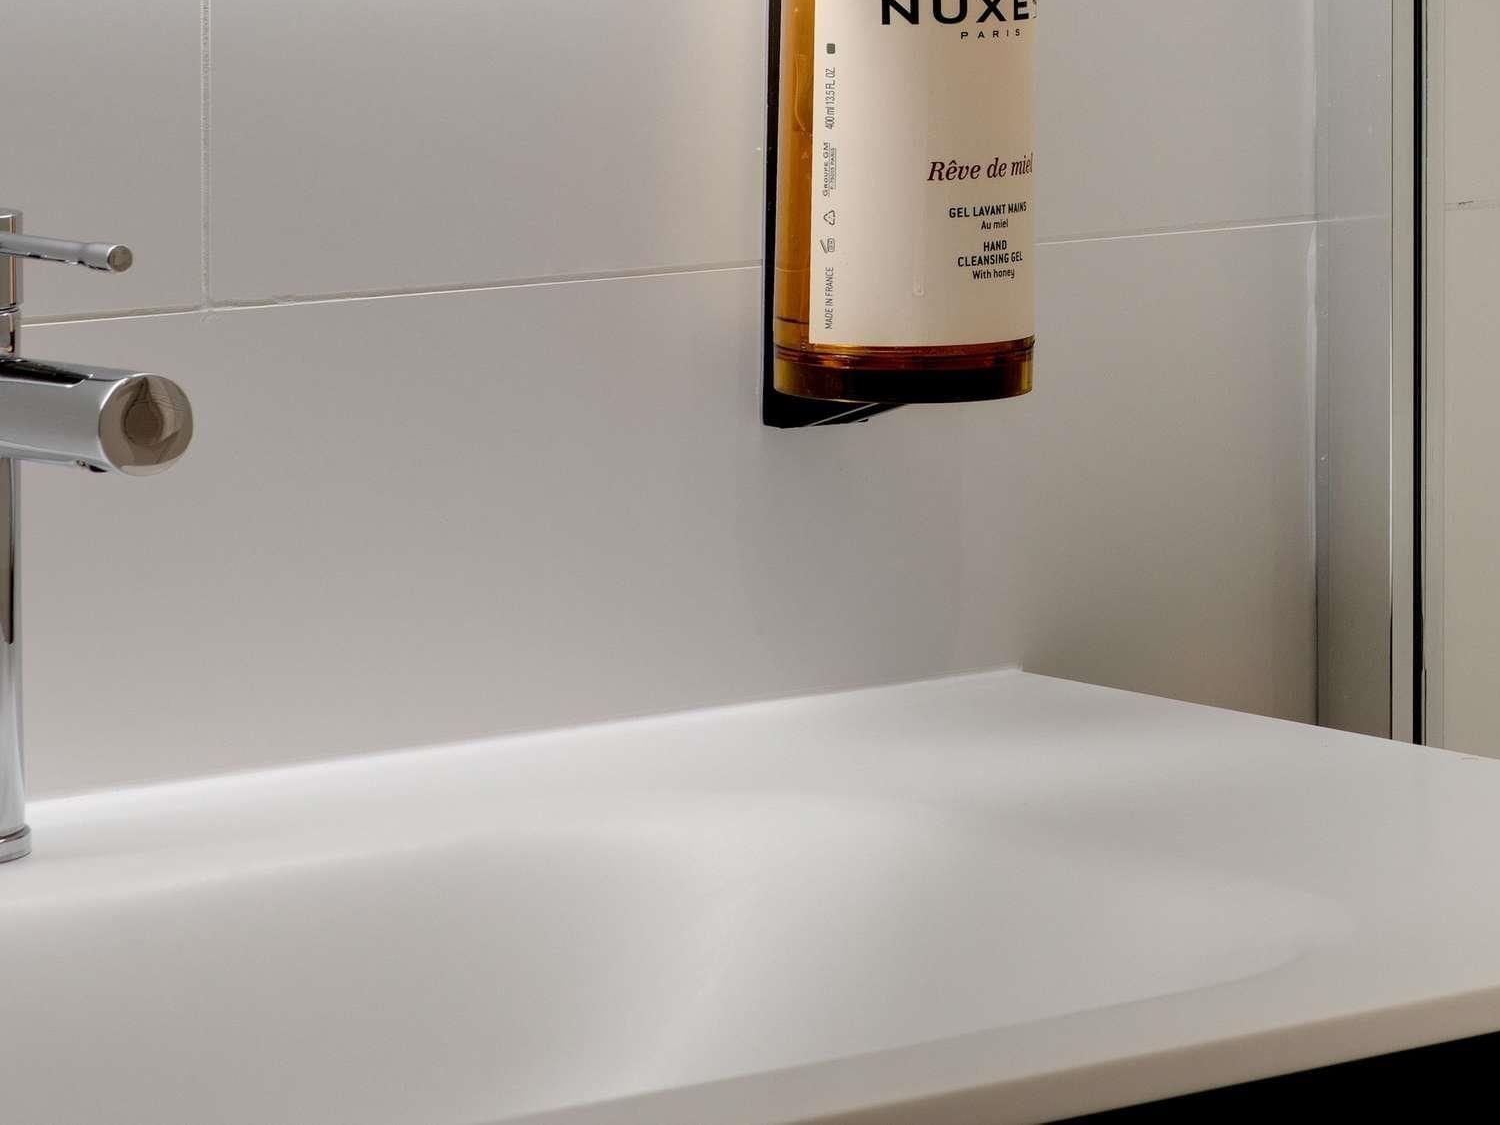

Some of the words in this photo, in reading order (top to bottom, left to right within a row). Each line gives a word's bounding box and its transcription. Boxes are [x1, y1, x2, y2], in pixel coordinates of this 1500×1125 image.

[960, 28, 1021, 40] PARIS
[927, 160, 981, 181] Rêve
[986, 157, 1007, 178] de
[1011, 152, 1033, 176] miel
[949, 207, 970, 218] GEL
[973, 204, 1006, 217] LAVANT
[1008, 201, 1027, 214] MAINS
[981, 220, 991, 230] Au
[993, 219, 1009, 229] miel
[983, 240, 1007, 252] HAND
[957, 253, 1009, 267] CLEANSING
[1011, 251, 1023, 262] GEL
[972, 269, 992, 280] With
[993, 268, 1015, 279] honey
[824, 267, 834, 297] FRANCE
[824, 298, 833, 307] IN
[824, 308, 833, 330] MADE
